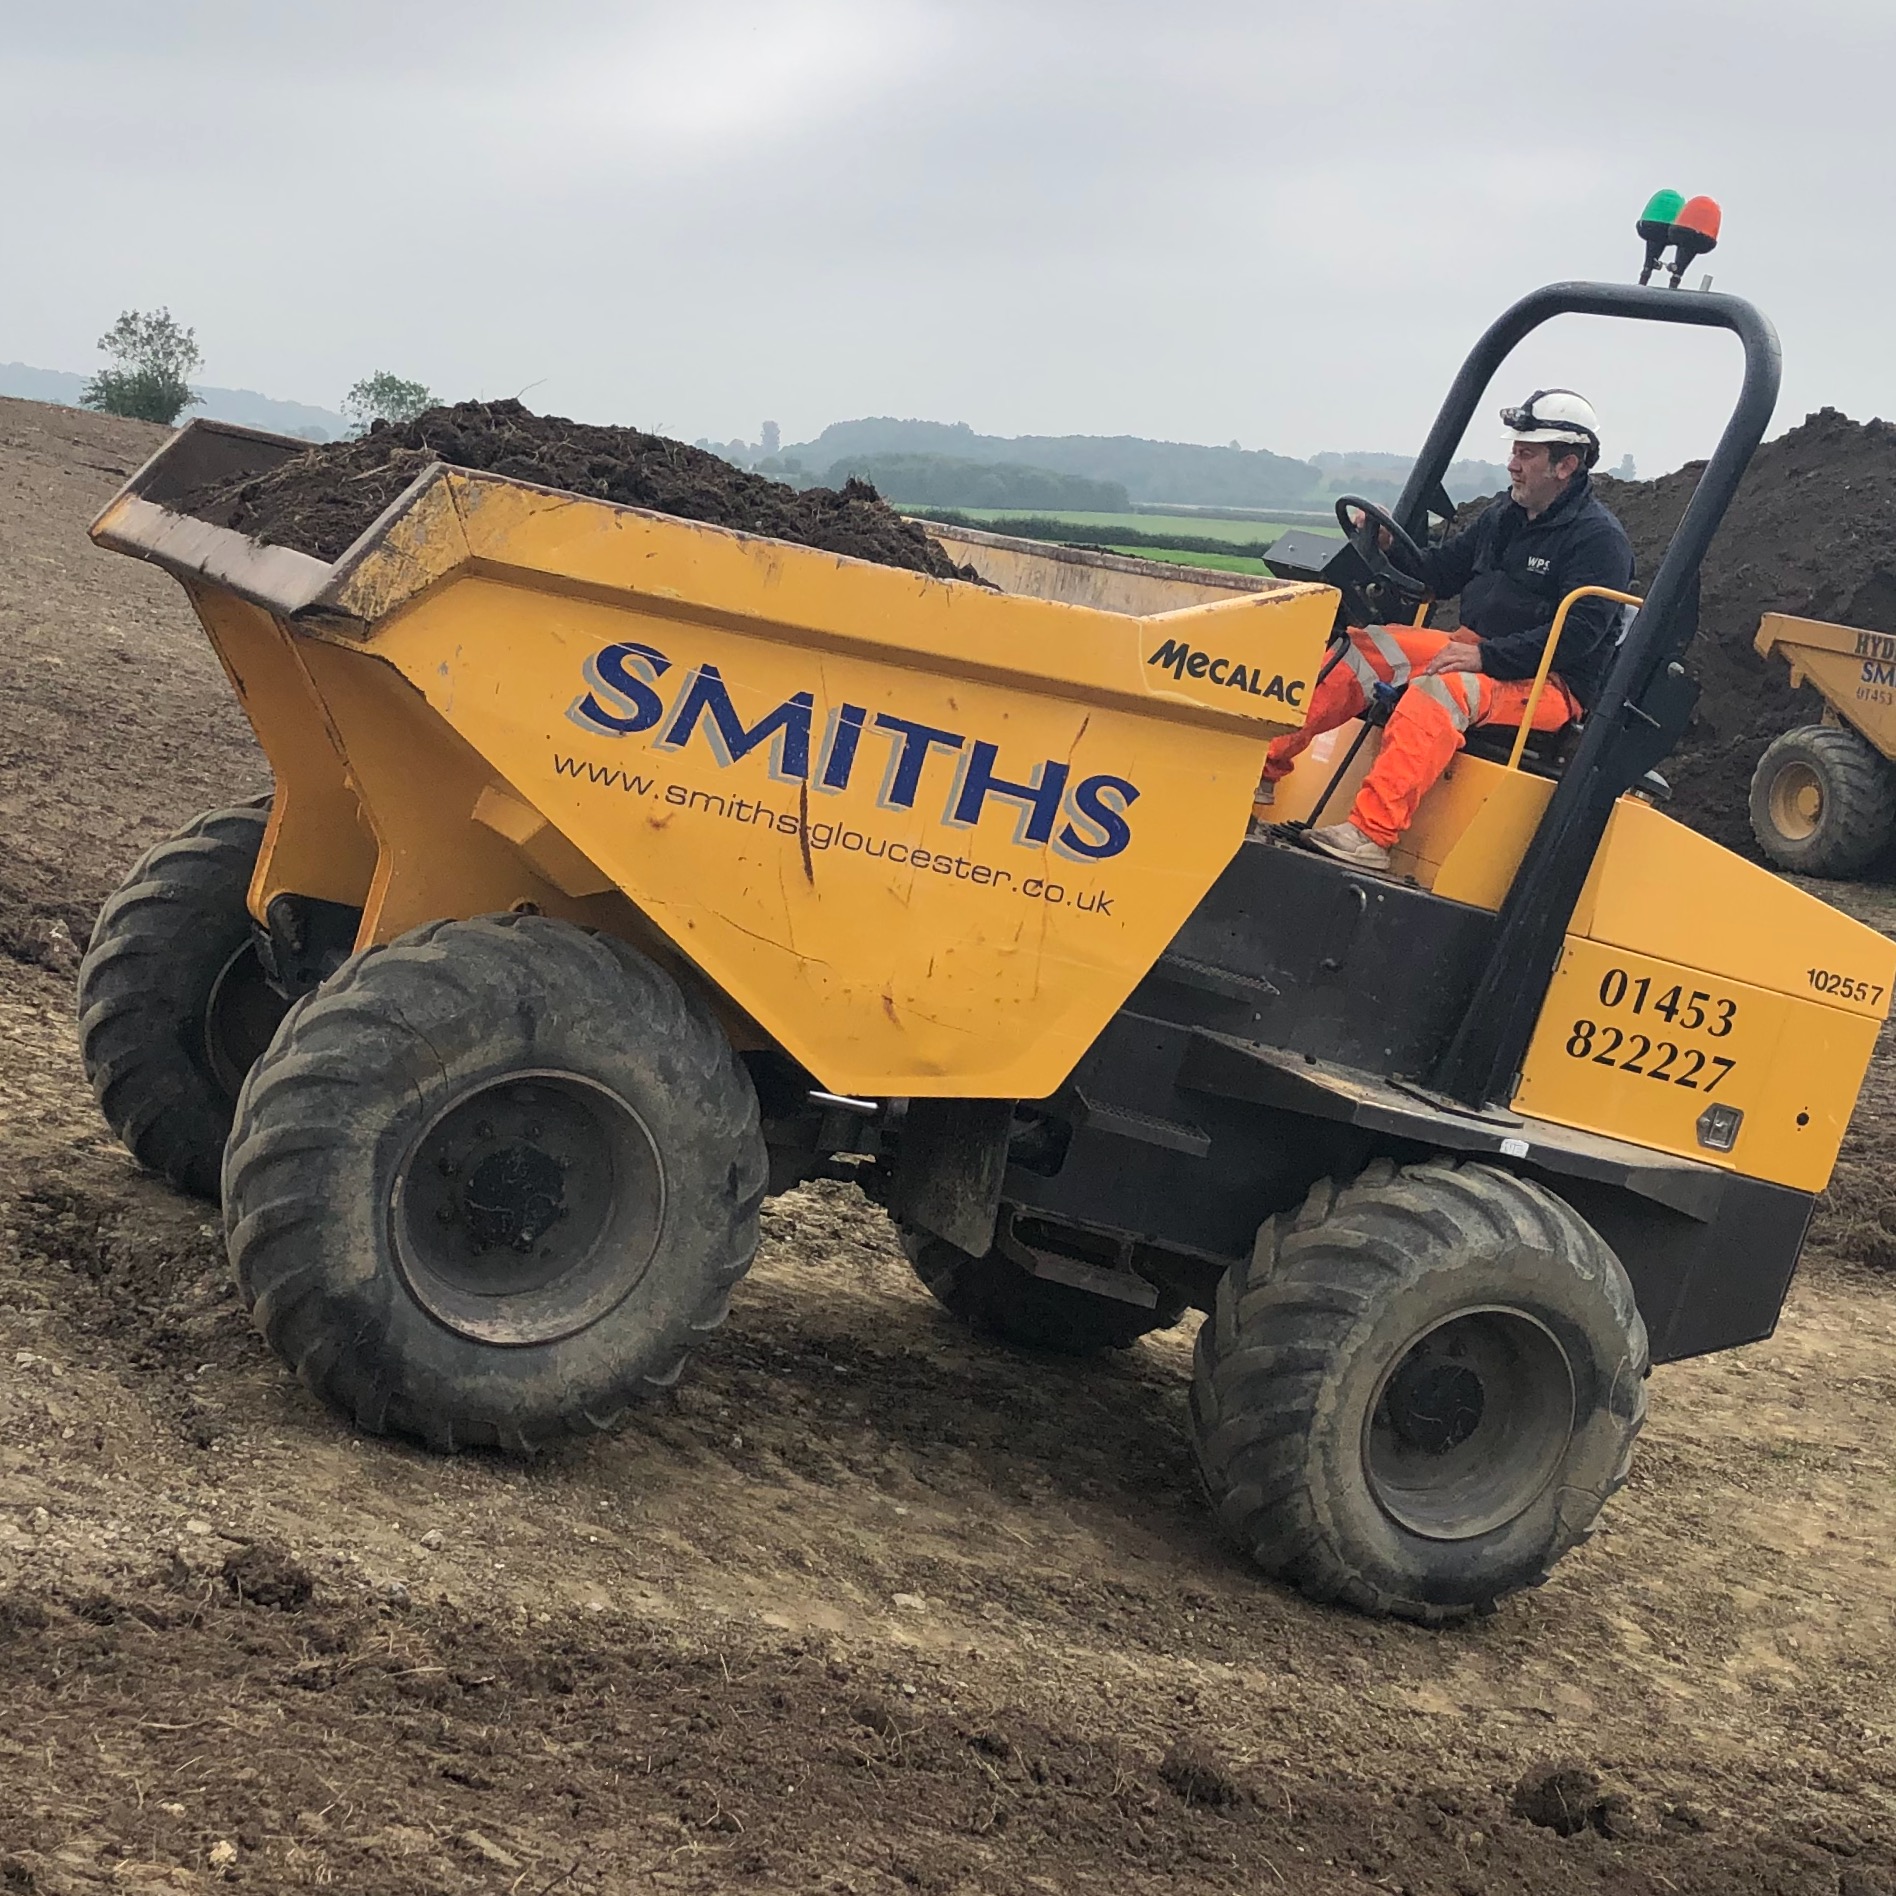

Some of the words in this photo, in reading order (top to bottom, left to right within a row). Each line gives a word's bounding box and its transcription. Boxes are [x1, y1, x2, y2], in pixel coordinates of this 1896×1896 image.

[1856, 633, 1896, 659] HYD
[1862, 662, 1896, 687] SM
[566, 642, 1141, 863] SMITHS
[1599, 968, 1737, 1037] 01453
[1807, 968, 1884, 1006] 102557
[1566, 1019, 1736, 1093] 822227
